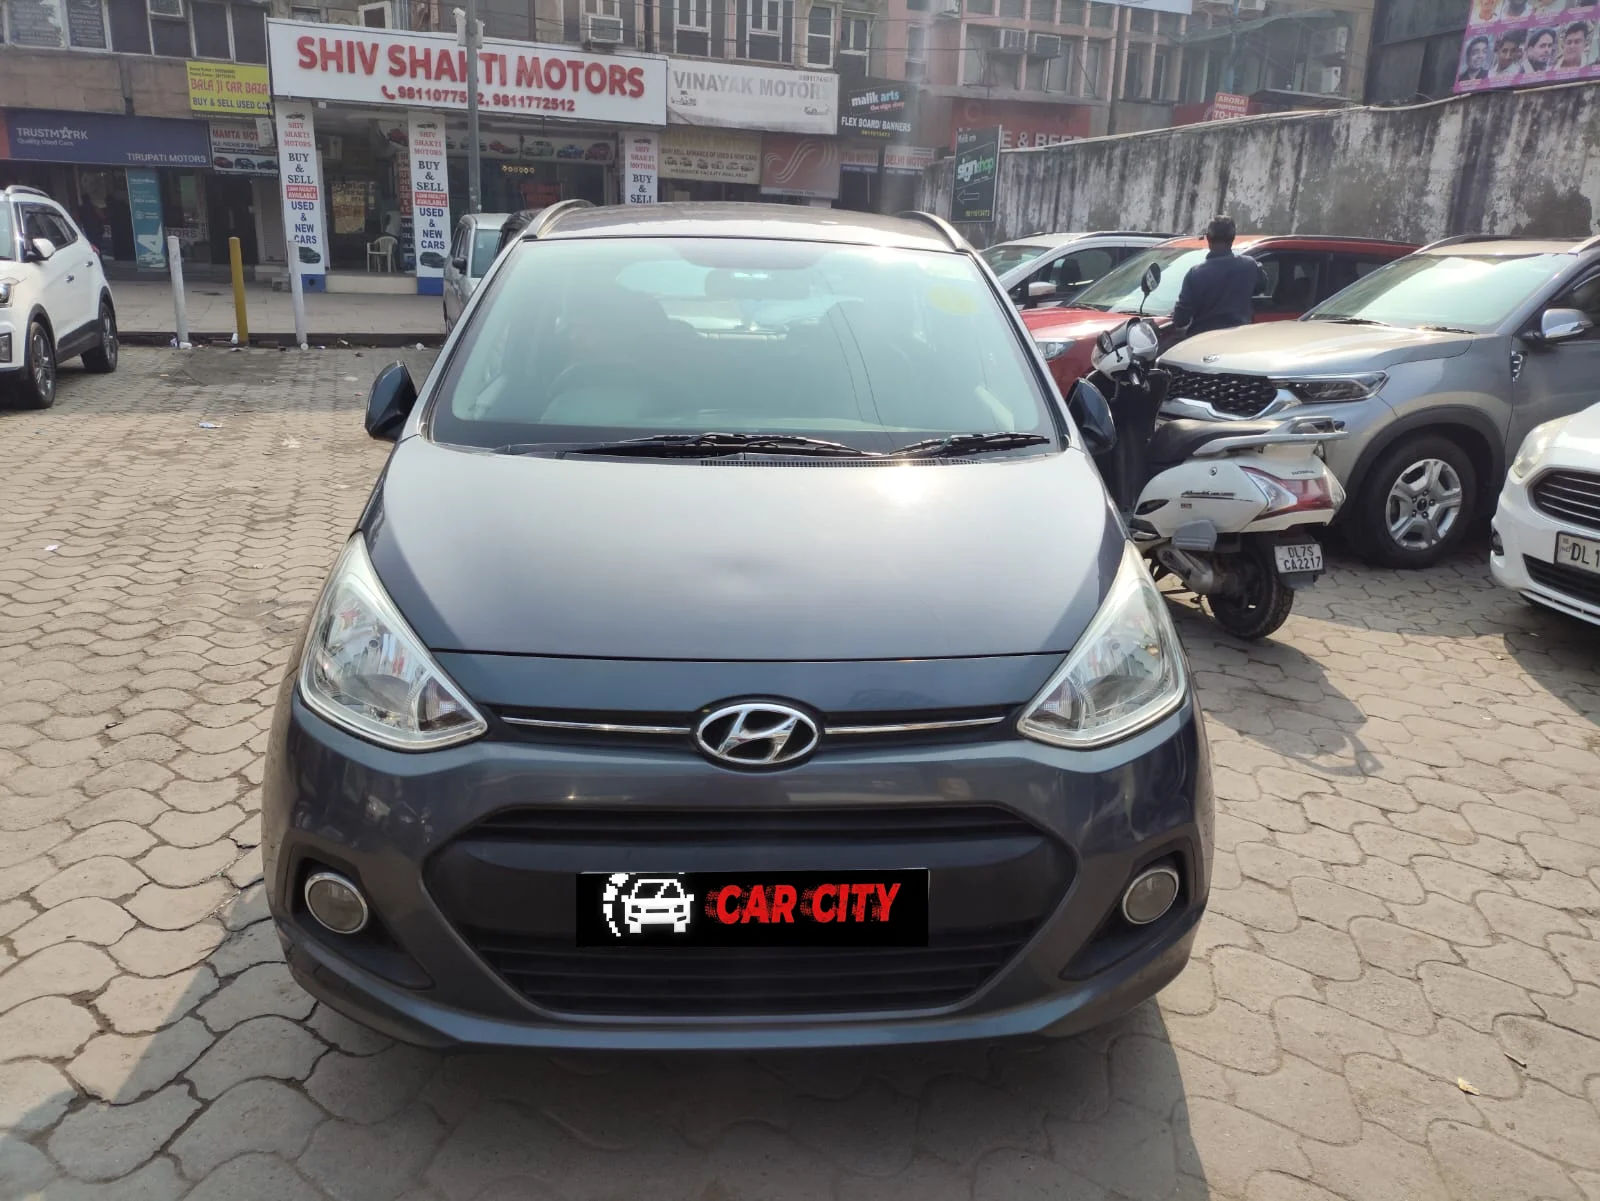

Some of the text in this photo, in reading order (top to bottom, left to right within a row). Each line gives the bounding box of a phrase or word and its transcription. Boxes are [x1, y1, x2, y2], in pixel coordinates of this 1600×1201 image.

[297, 36, 379, 76] SHIV
[515, 55, 645, 99] MOTORS
[673, 70, 753, 94] VINAYAK
[226, 81, 242, 94] CAR
[192, 97, 207, 106] BUY
[217, 98, 235, 108] SELL
[236, 100, 255, 109] USED
[493, 93, 575, 112] 9811772512
[851, 90, 900, 107] malik arts
[841, 116, 857, 127] FLEX
[882, 120, 911, 132] BANNERS
[127, 153, 207, 163] TIRUPATI MOTORS
[288, 153, 309, 162] BUY
[295, 164, 305, 173] &
[418, 161, 440, 170] BUY
[288, 175, 314, 184] SELL
[425, 171, 435, 180] &
[633, 174, 652, 183] BUY
[416, 182, 444, 191] SELL
[638, 185, 648, 193] &
[291, 201, 314, 210] USED
[419, 208, 443, 217] USED
[301, 213, 307, 222] &
[429, 219, 436, 228] &
[295, 224, 314, 233] NEW
[423, 229, 443, 239] NEW
[294, 234, 317, 244] CARS
[421, 240, 446, 249] CARS
[1288, 546, 1314, 558] DL7S
[1571, 542, 1589, 564] DL
[1284, 556, 1321, 570] CA2217
